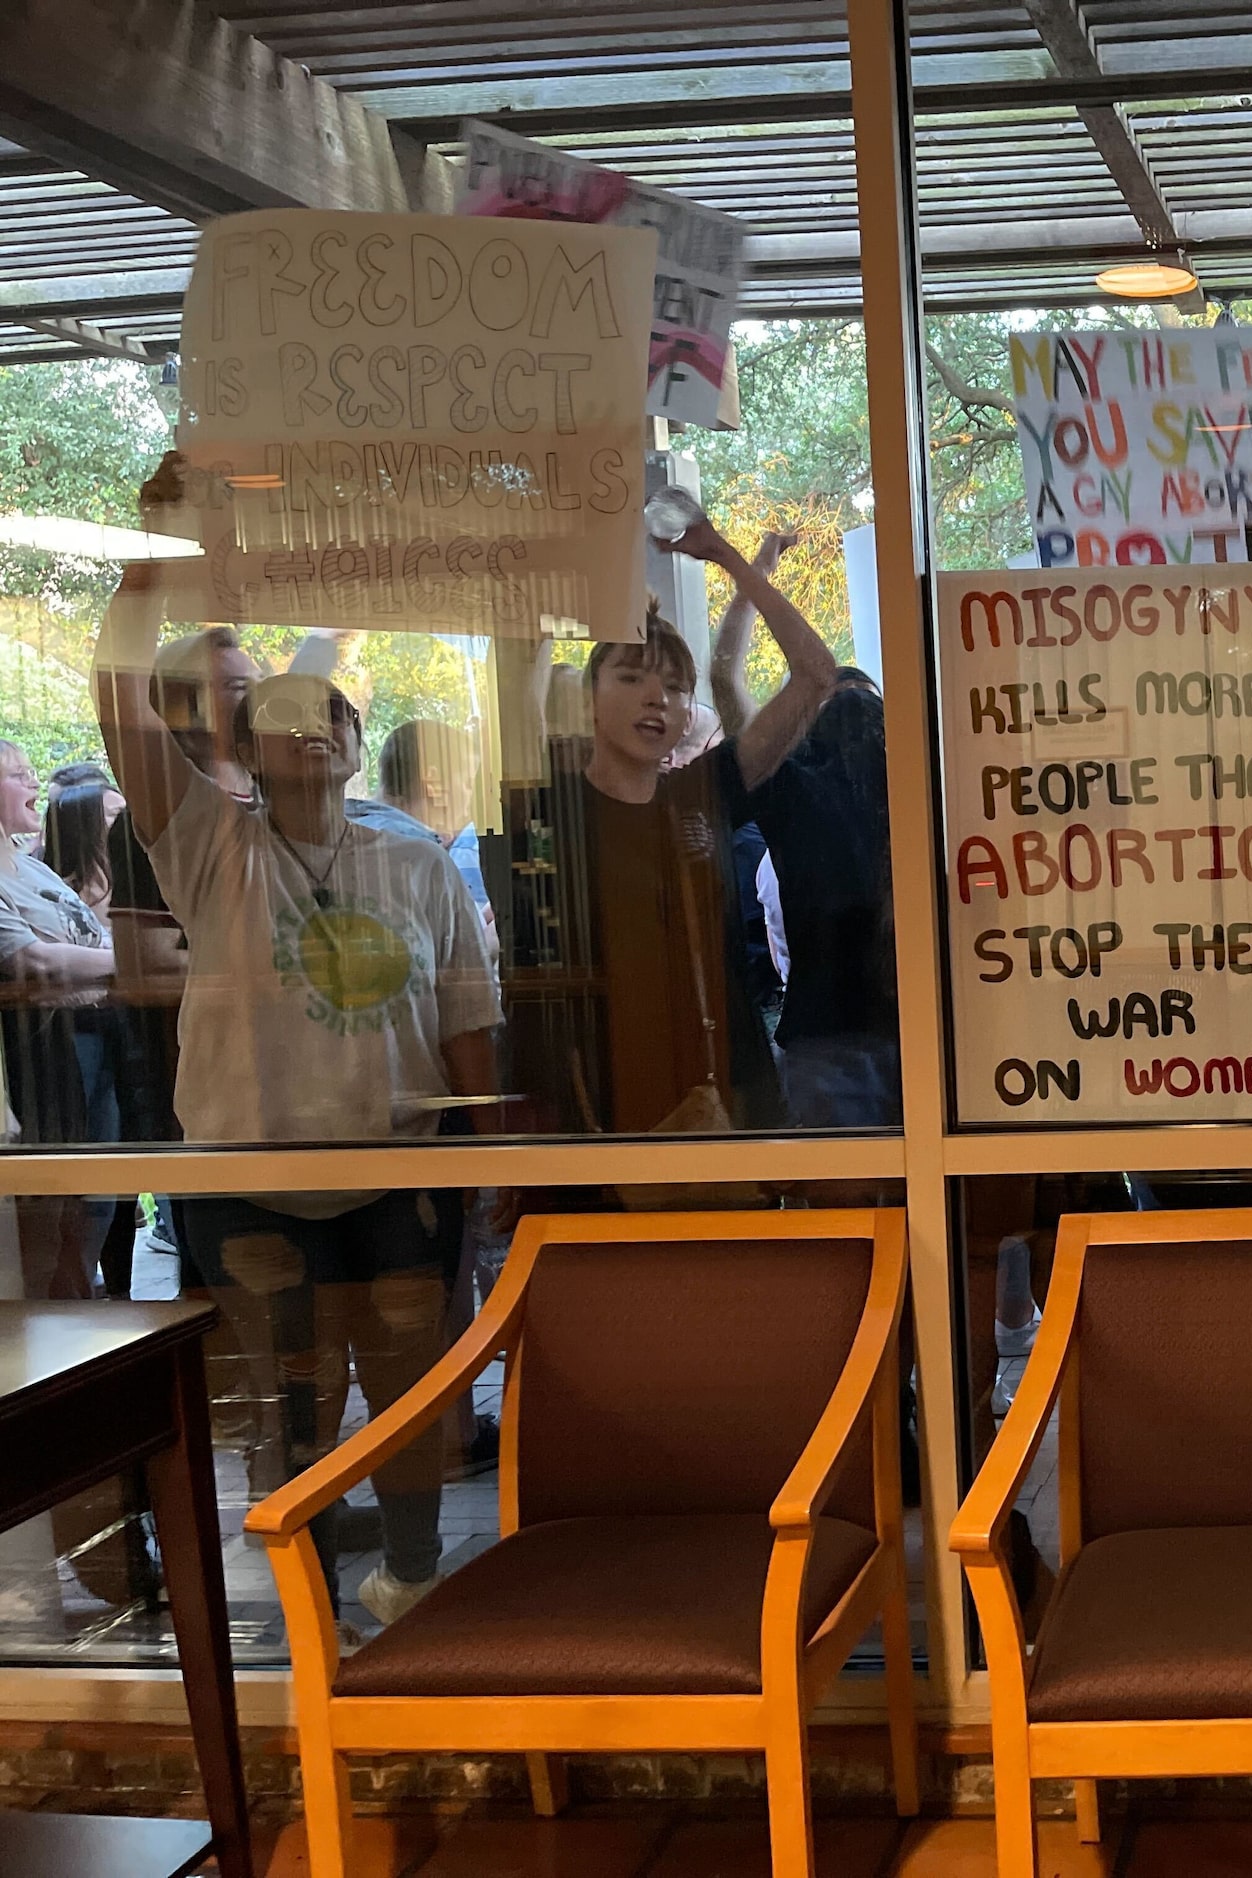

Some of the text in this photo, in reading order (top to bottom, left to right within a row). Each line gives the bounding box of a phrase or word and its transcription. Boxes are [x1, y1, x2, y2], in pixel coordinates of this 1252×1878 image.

[210, 229, 622, 342] FREEDOM
[205, 358, 247, 417] IS
[278, 341, 591, 436] RESPECT
[1009, 335, 1104, 401] MAY
[1118, 334, 1195, 390] THE
[1017, 398, 1129, 482] YOU
[266, 440, 629, 514] INDIVIDUALS
[1036, 481, 1066, 522] A
[1072, 470, 1132, 521] GAY
[969, 672, 1107, 735] KILLS
[981, 756, 1159, 820] PEOPLE
[973, 921, 1123, 983] STOP
[1067, 989, 1196, 1040] WAR
[994, 1058, 1081, 1106] ON
